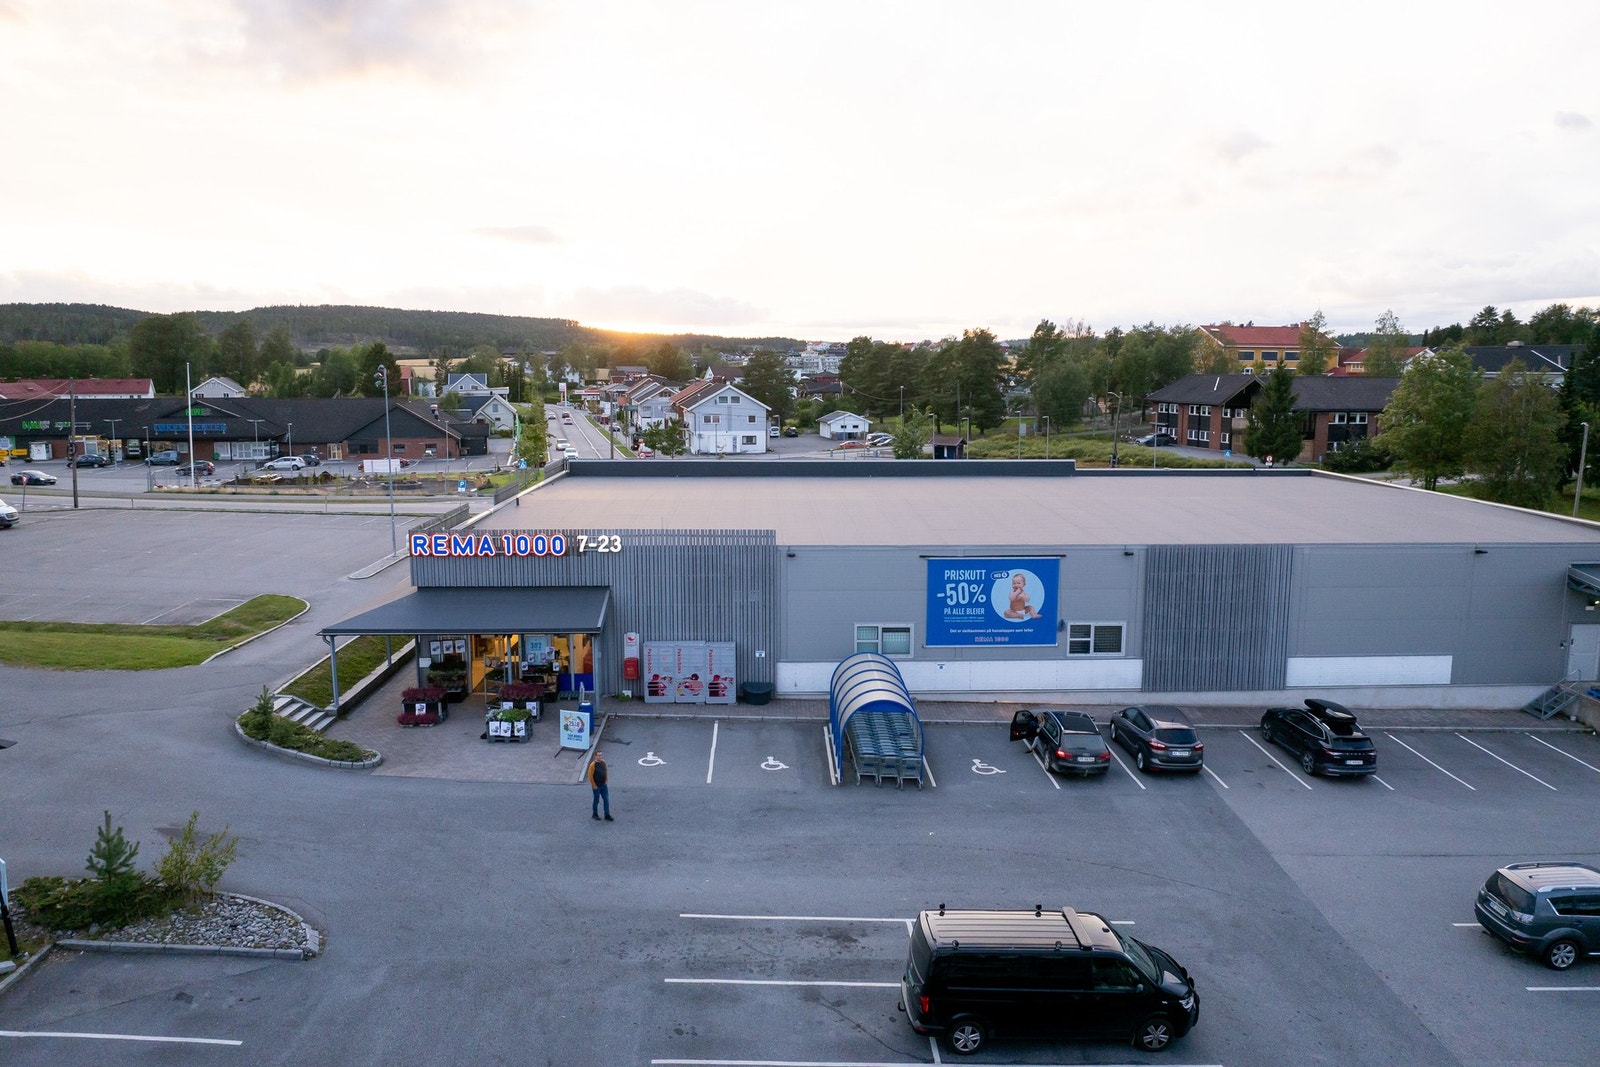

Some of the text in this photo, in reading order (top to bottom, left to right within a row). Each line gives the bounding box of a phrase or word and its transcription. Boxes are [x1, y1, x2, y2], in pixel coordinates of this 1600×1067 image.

[411, 534, 622, 557] REMA 1000 7-23
[944, 569, 986, 581] PRISKUTT
[936, 582, 987, 606] -50%
[944, 607, 951, 615] PÅ
